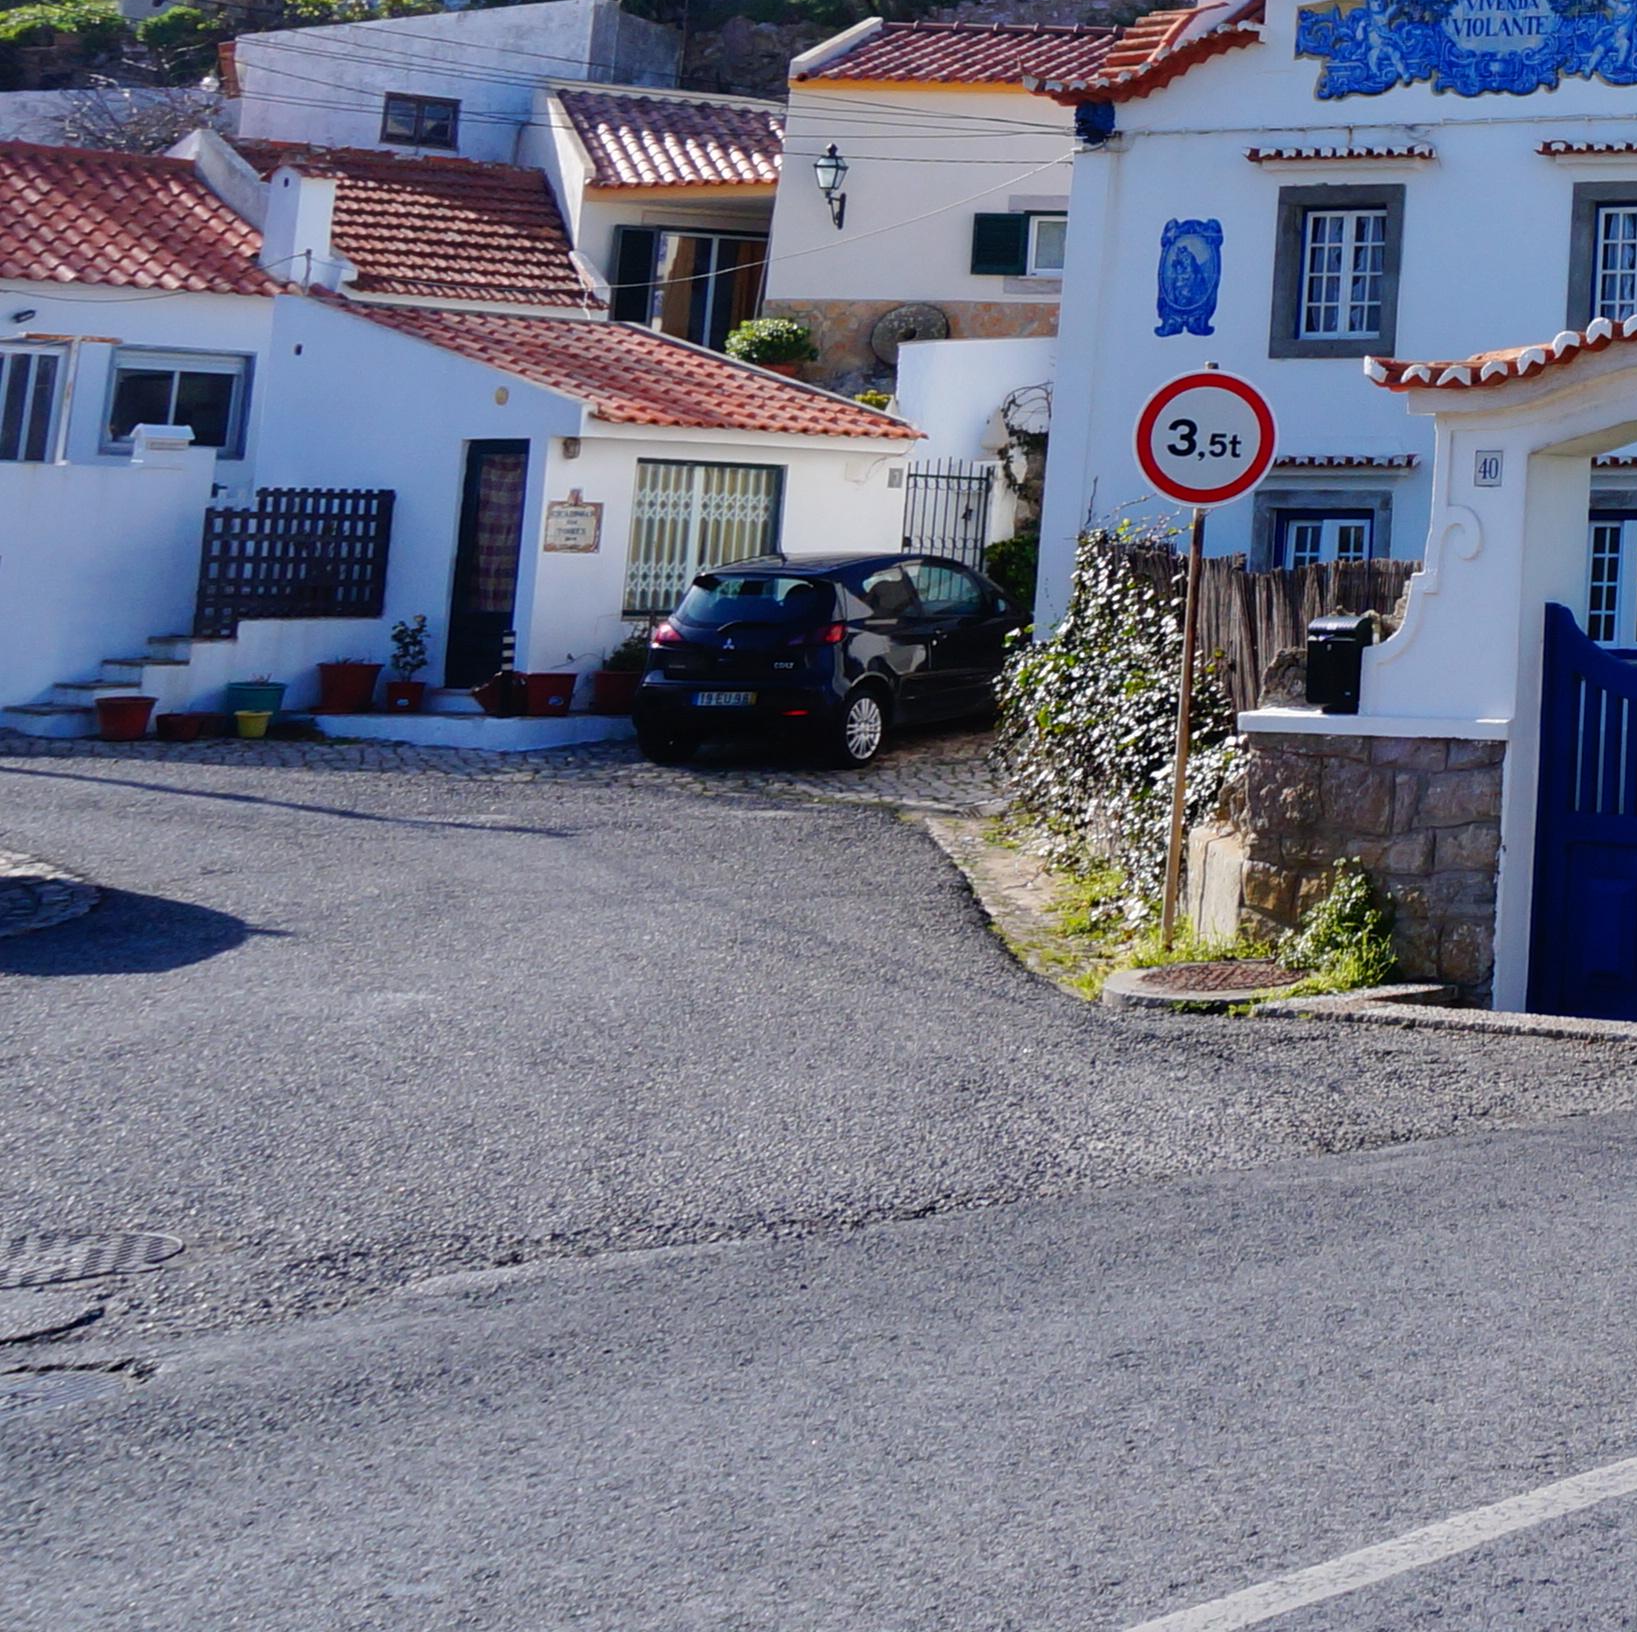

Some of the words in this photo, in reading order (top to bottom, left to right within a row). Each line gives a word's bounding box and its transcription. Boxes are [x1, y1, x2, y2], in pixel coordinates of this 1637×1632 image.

[1452, 16, 1548, 37] VIOLANTE
[1167, 418, 1242, 461] 3,5t
[1478, 457, 1499, 480] 40
